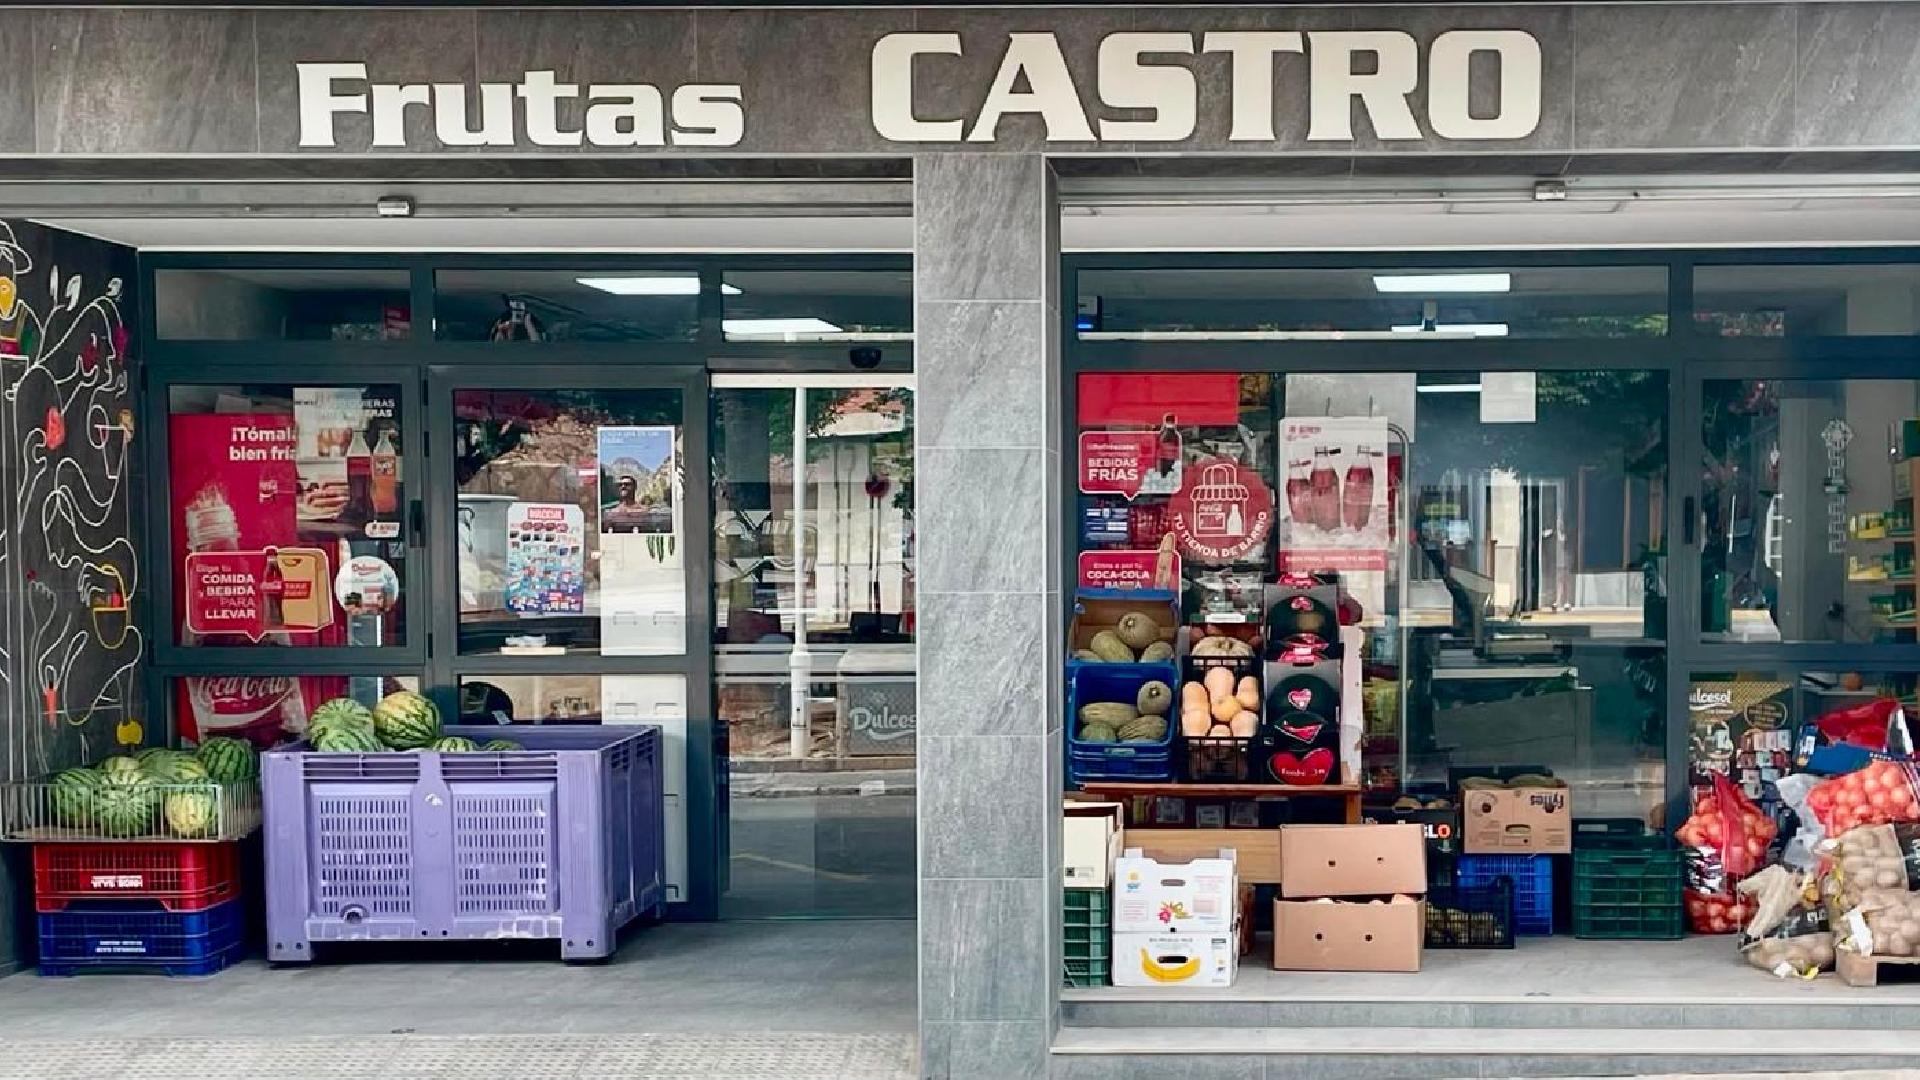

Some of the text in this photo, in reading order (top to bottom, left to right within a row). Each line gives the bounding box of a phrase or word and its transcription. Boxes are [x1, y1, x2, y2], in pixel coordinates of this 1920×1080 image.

[296, 30, 1541, 147] Frutas CASTRO
[229, 445, 267, 461] bien
[1087, 457, 1138, 468] BEBIDAS
[1088, 467, 1139, 481] FRÍAS
[1173, 511, 1267, 558] TU TIENDA DE BARRIO
[202, 573, 255, 584] COMIDA
[1086, 570, 1150, 579] COCA-COLA
[206, 585, 256, 597] BEBIDA
[220, 597, 255, 606] PARA
[204, 609, 256, 619] LLEVAR
